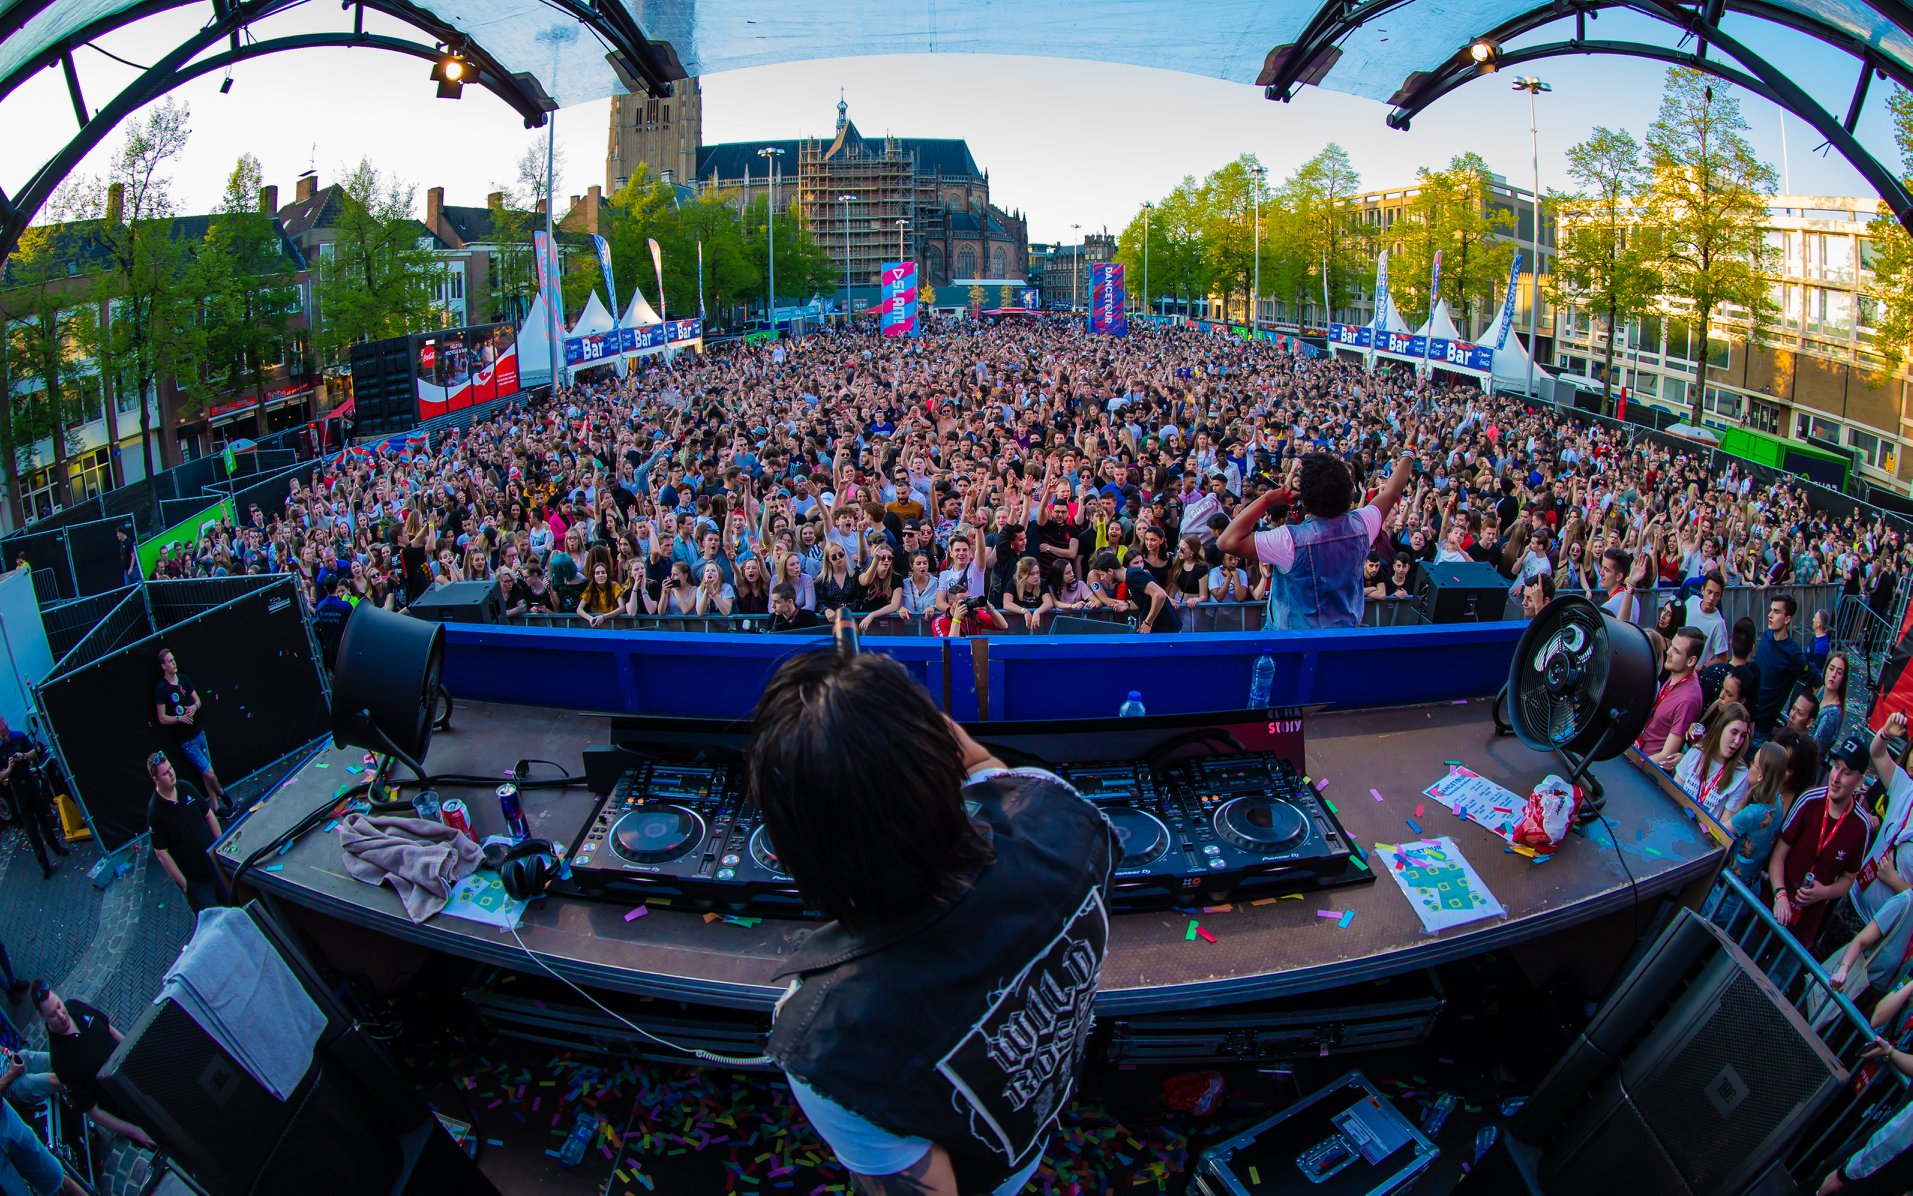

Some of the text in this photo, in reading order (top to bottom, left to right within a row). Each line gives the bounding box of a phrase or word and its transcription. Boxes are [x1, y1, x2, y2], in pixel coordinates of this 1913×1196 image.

[892, 280, 906, 324] SLAM!
[1104, 266, 1113, 324] DANCETOUR
[633, 329, 652, 349] Bar
[676, 322, 692, 340] Bar
[1340, 326, 1359, 345] Bar
[581, 338, 605, 361] Bar
[1388, 333, 1410, 354] Bar
[1446, 342, 1473, 365] Bar
[1190, 501, 1212, 518] GOLD
[986, 938, 1097, 1074] WILD
